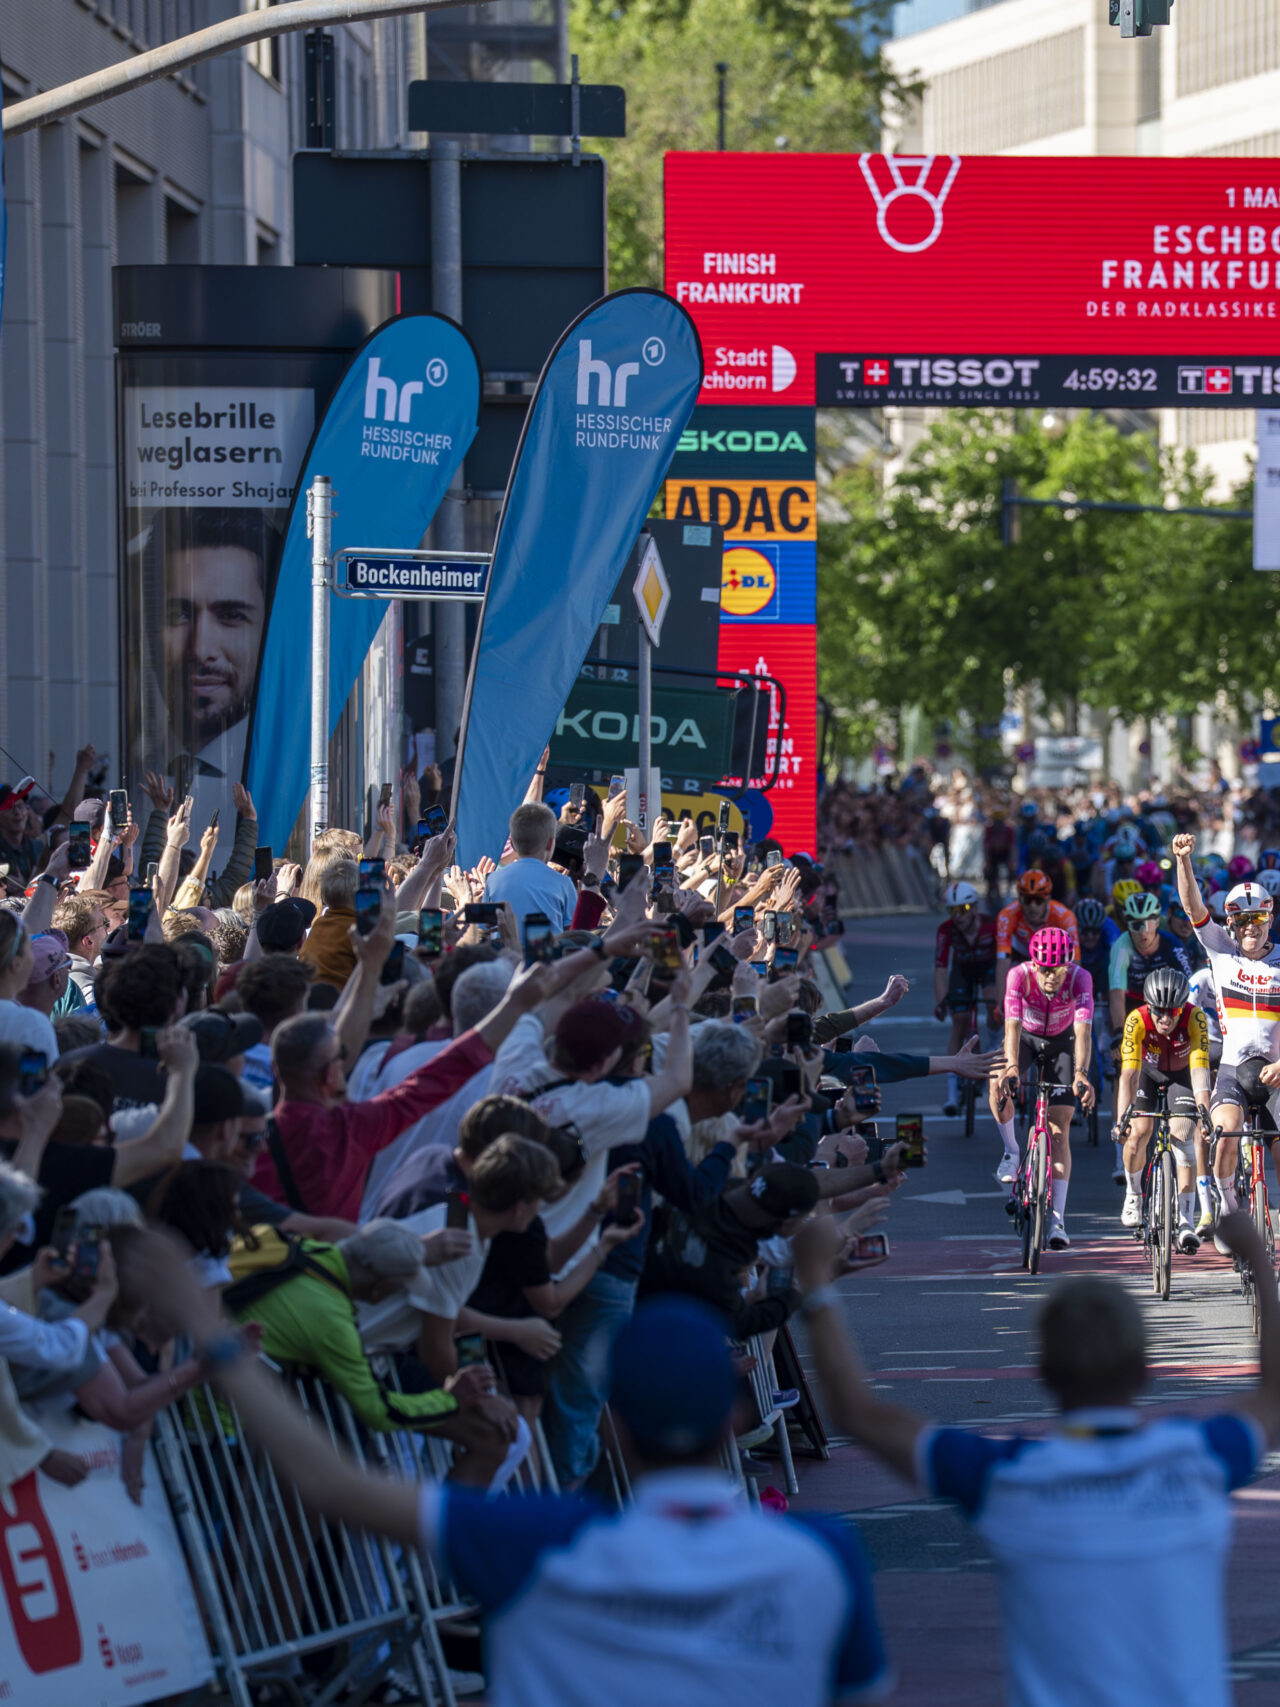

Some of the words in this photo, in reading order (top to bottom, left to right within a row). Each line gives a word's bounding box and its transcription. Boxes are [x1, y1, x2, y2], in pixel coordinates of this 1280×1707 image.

[1225, 187, 1236, 208] 1
[703, 252, 776, 275] FINISH
[676, 281, 804, 304] FRANKFURT
[1086, 301, 1126, 317] DER
[121, 322, 162, 337] STRÖER
[715, 347, 768, 367] Stadt
[576, 339, 640, 407] hr
[894, 359, 1040, 387] TISSOT
[1063, 368, 1157, 391] 4:59:32
[364, 357, 424, 423] hr
[836, 390, 880, 400] SWISS
[887, 390, 951, 400] WATCHES
[958, 390, 1001, 400] SINCE
[141, 402, 276, 429] Lesebrille
[576, 413, 672, 433] HESSISCHER
[363, 425, 452, 450] HESSISCHER
[576, 432, 661, 450] RUNDFUNK
[137, 437, 282, 470] weglasern
[361, 442, 440, 466] RUNDFUNK
[130, 481, 147, 497] bei
[151, 481, 225, 498] Professor
[674, 486, 810, 533] ADAC
[357, 562, 482, 588] Bockenheimer
